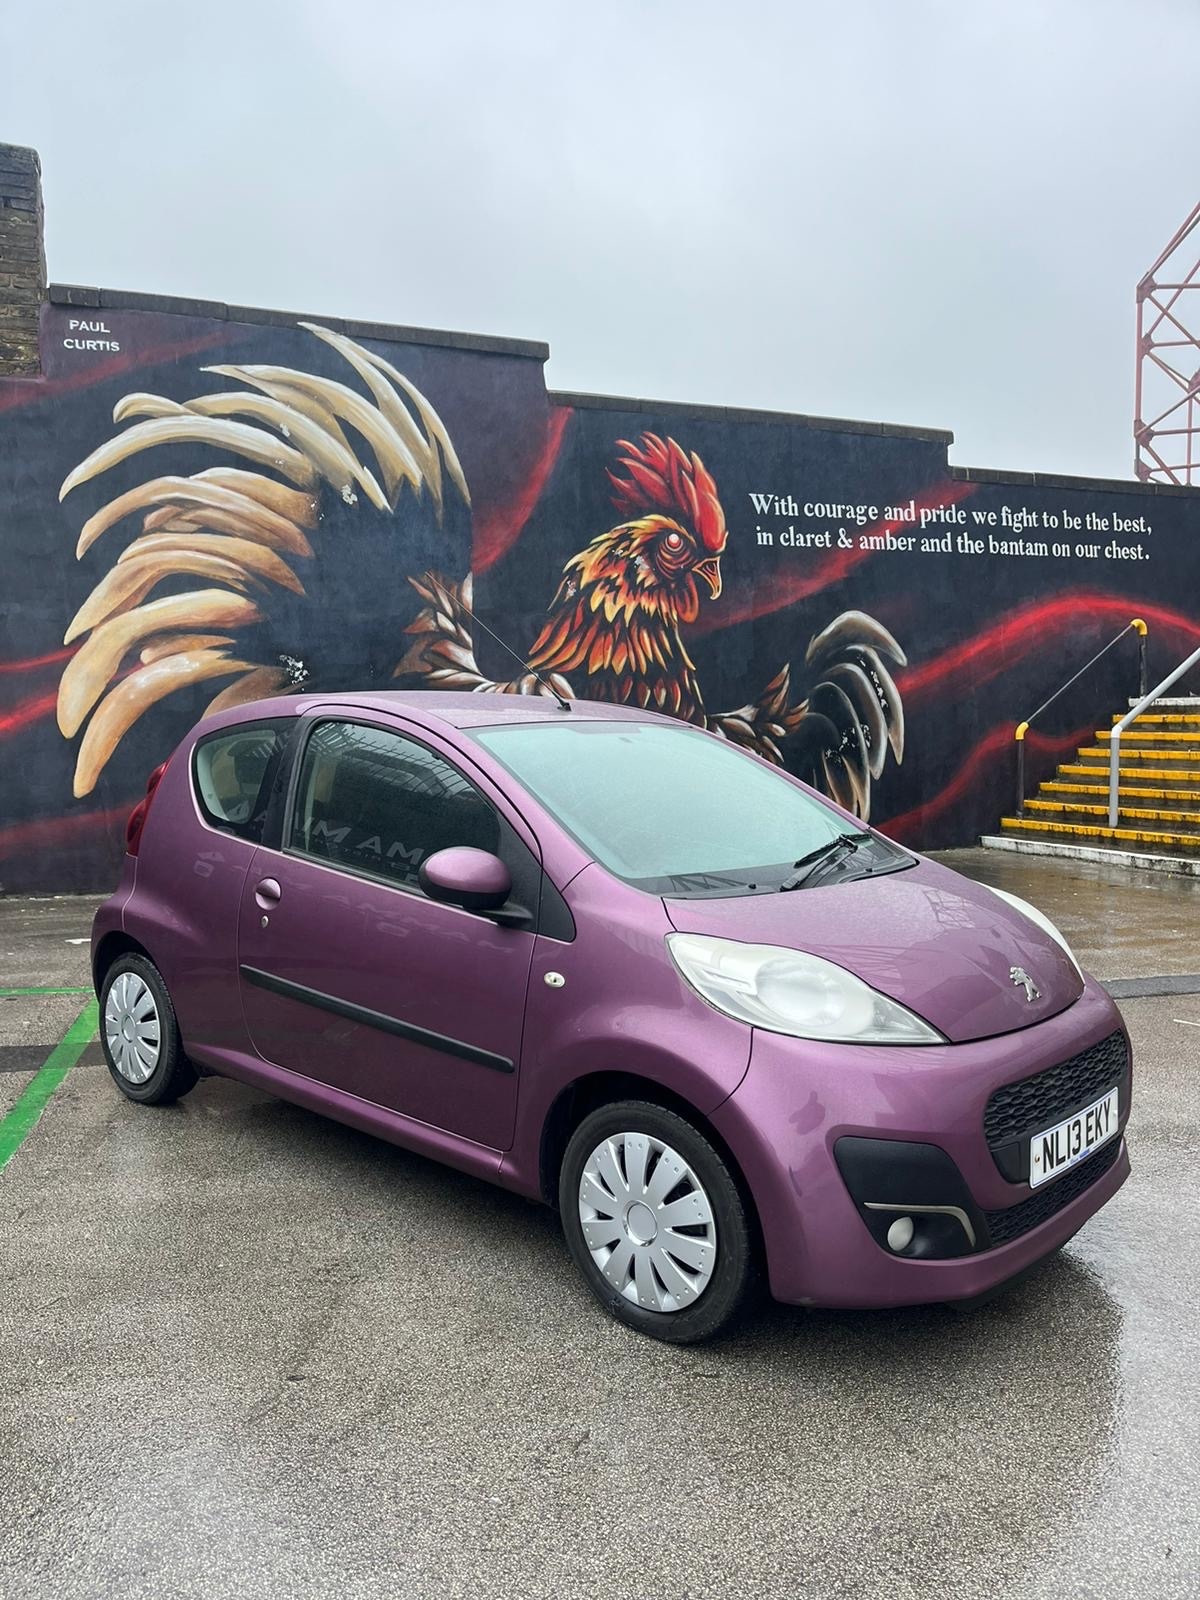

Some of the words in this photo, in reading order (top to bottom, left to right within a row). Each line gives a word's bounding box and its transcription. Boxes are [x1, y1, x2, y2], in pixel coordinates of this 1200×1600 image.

[69, 319, 111, 333] PAUL
[63, 338, 120, 352] CURTIS
[748, 492, 799, 517] With
[804, 502, 879, 526] courage
[884, 500, 916, 522] and
[920, 503, 967, 529] pride
[971, 511, 997, 526] we
[1000, 505, 1039, 533] fight
[1042, 511, 1059, 528] to
[1062, 509, 1082, 530] be
[1085, 512, 1109, 531] the
[1112, 512, 1152, 536] best,
[756, 525, 773, 546] in
[779, 525, 832, 548] claret
[837, 527, 853, 549] &
[859, 529, 916, 551] amber
[920, 532, 952, 553] and
[956, 532, 984, 554] the
[988, 534, 1049, 557] bantam
[1052, 542, 1071, 557] on
[1075, 543, 1101, 558] our
[1104, 540, 1150, 560] chest.
[1042, 1119, 1082, 1174] NL13
[1086, 1097, 1111, 1148] EKY
